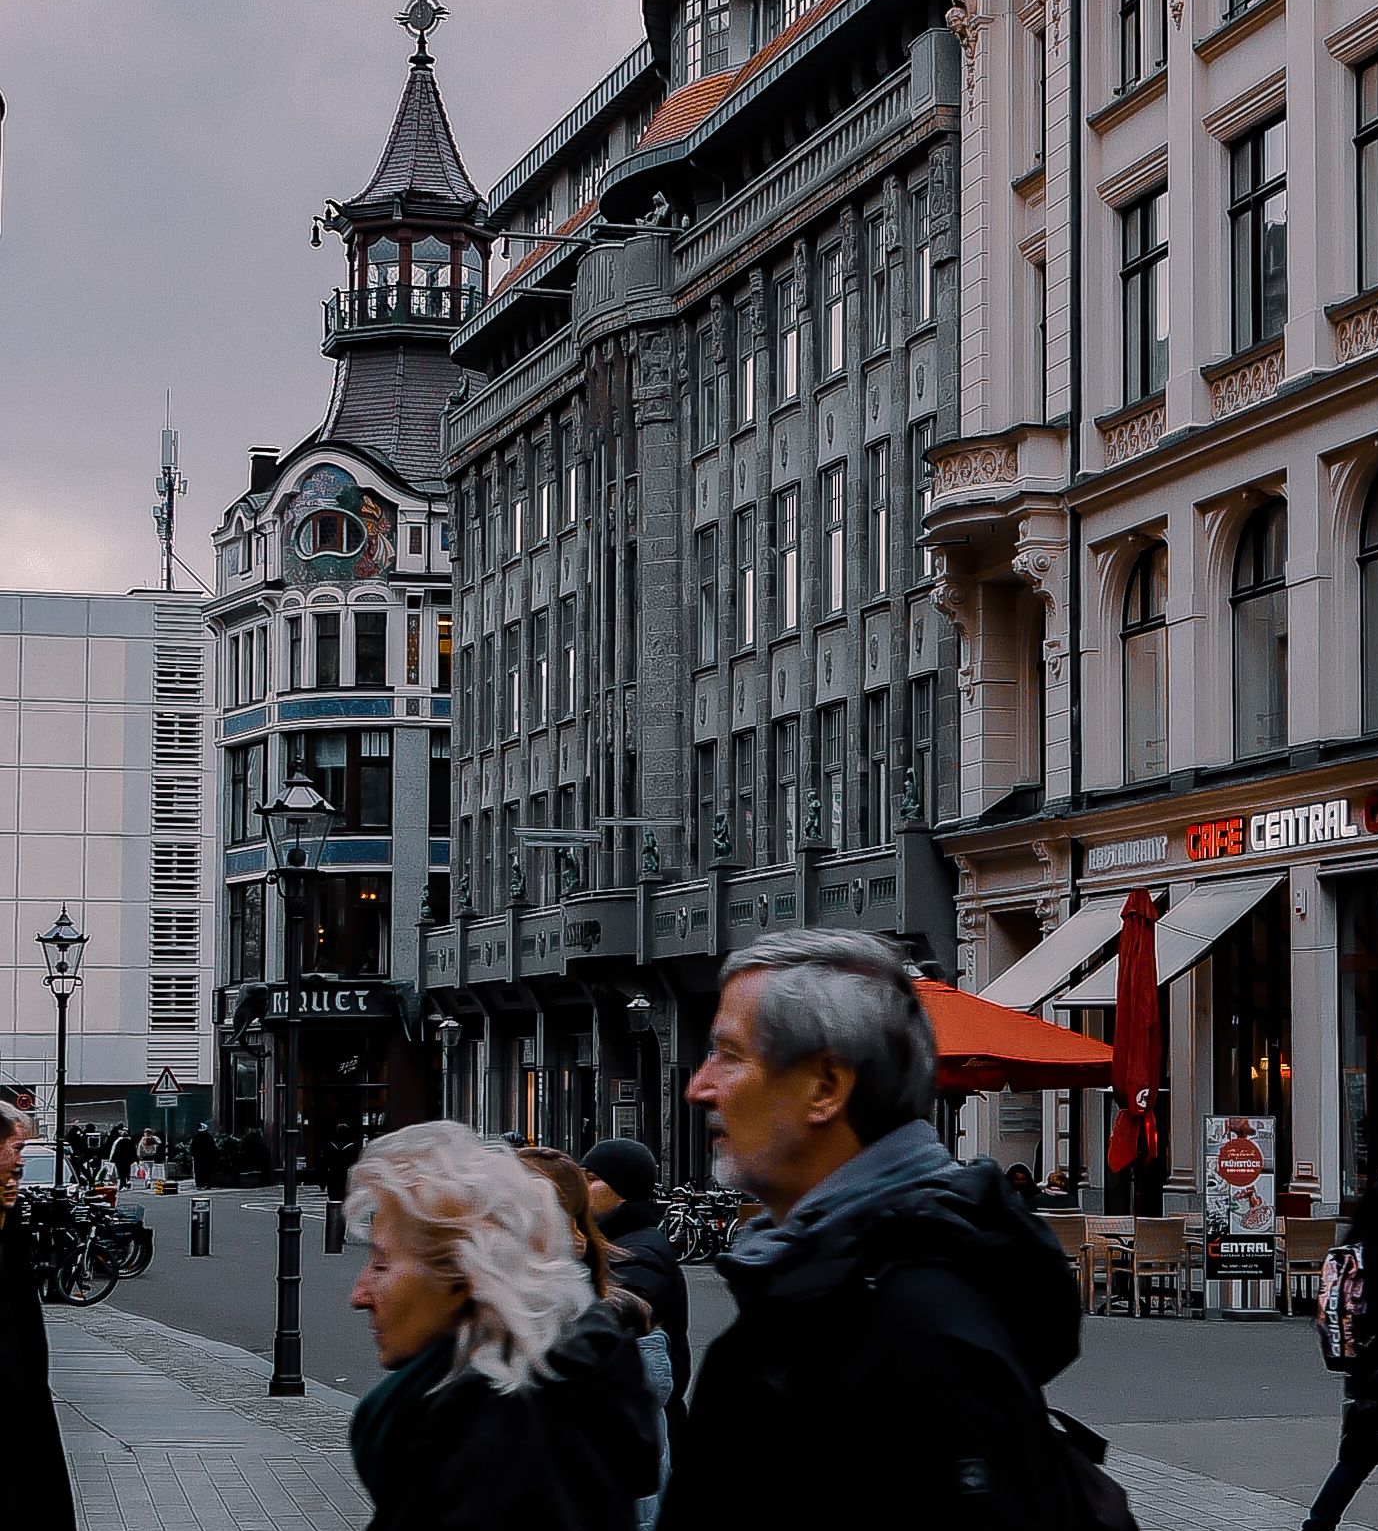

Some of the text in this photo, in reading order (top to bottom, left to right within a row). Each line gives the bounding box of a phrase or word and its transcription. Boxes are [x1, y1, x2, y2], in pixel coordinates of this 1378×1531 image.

[1088, 835, 1168, 870] RESTAURANT
[1187, 818, 1243, 861] CAFE
[1250, 799, 1358, 852] CENTRAL
[1326, 1285, 1341, 1357] adidas
